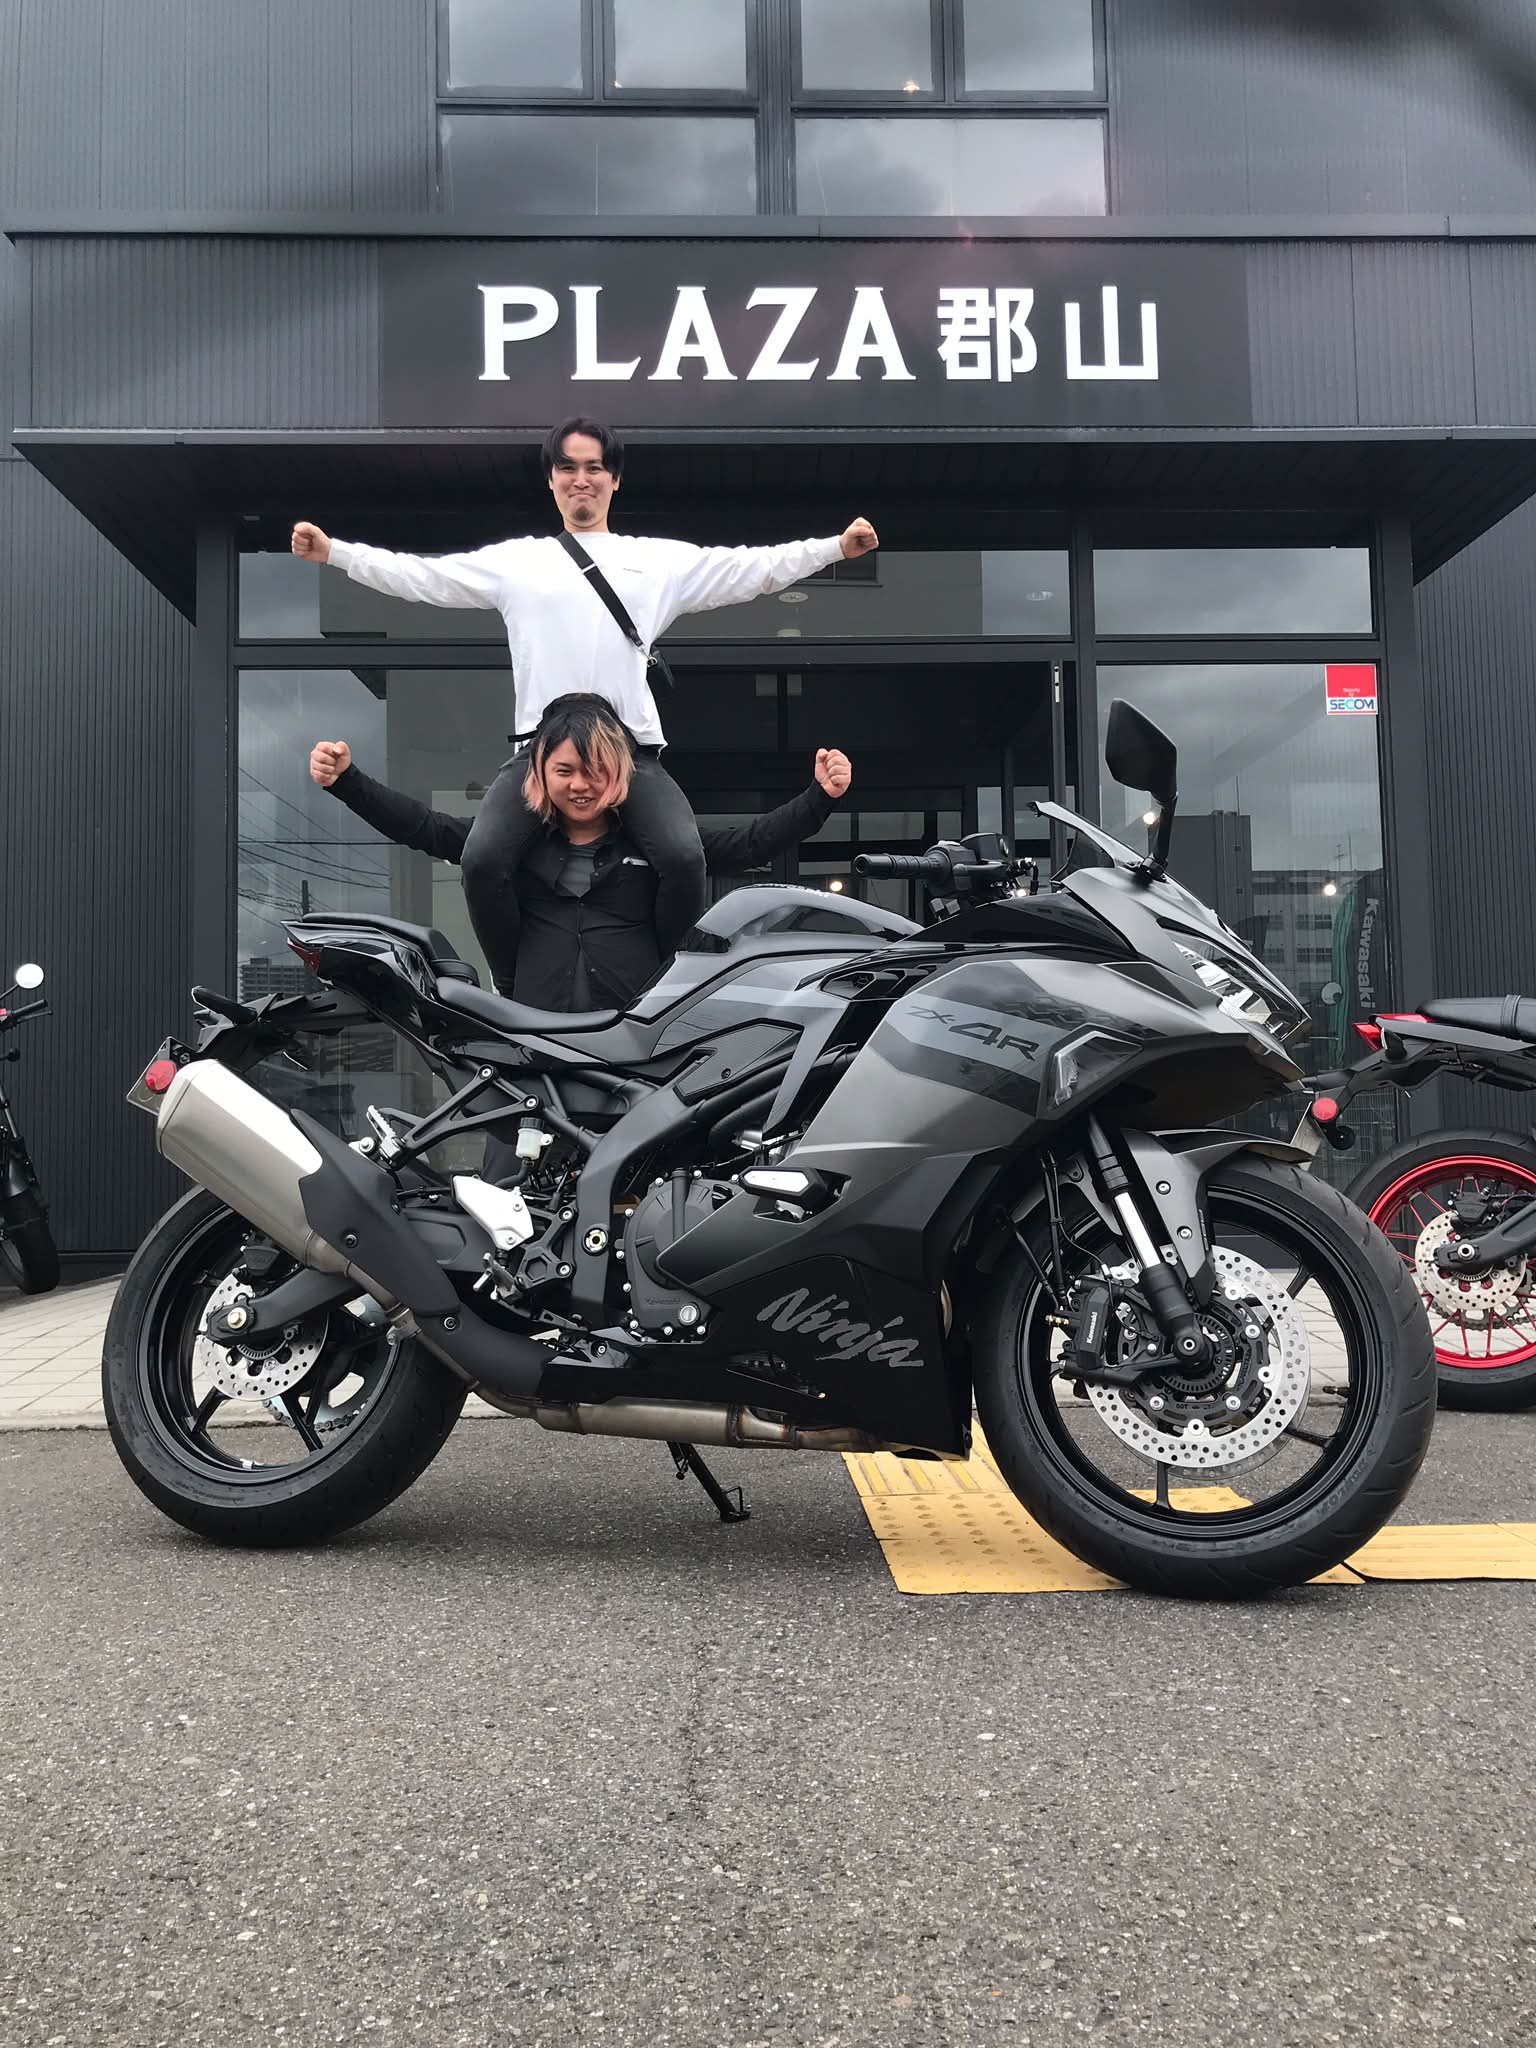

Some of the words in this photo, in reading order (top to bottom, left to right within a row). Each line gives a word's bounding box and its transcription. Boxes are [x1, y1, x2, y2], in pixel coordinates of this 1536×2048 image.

[477, 284, 917, 381] PLAZA
[936, 285, 1159, 383] 郡山
[1329, 698, 1375, 710] SECOM
[1357, 898, 1379, 1008] Kawasaki
[756, 1287, 925, 1368] Ninja
